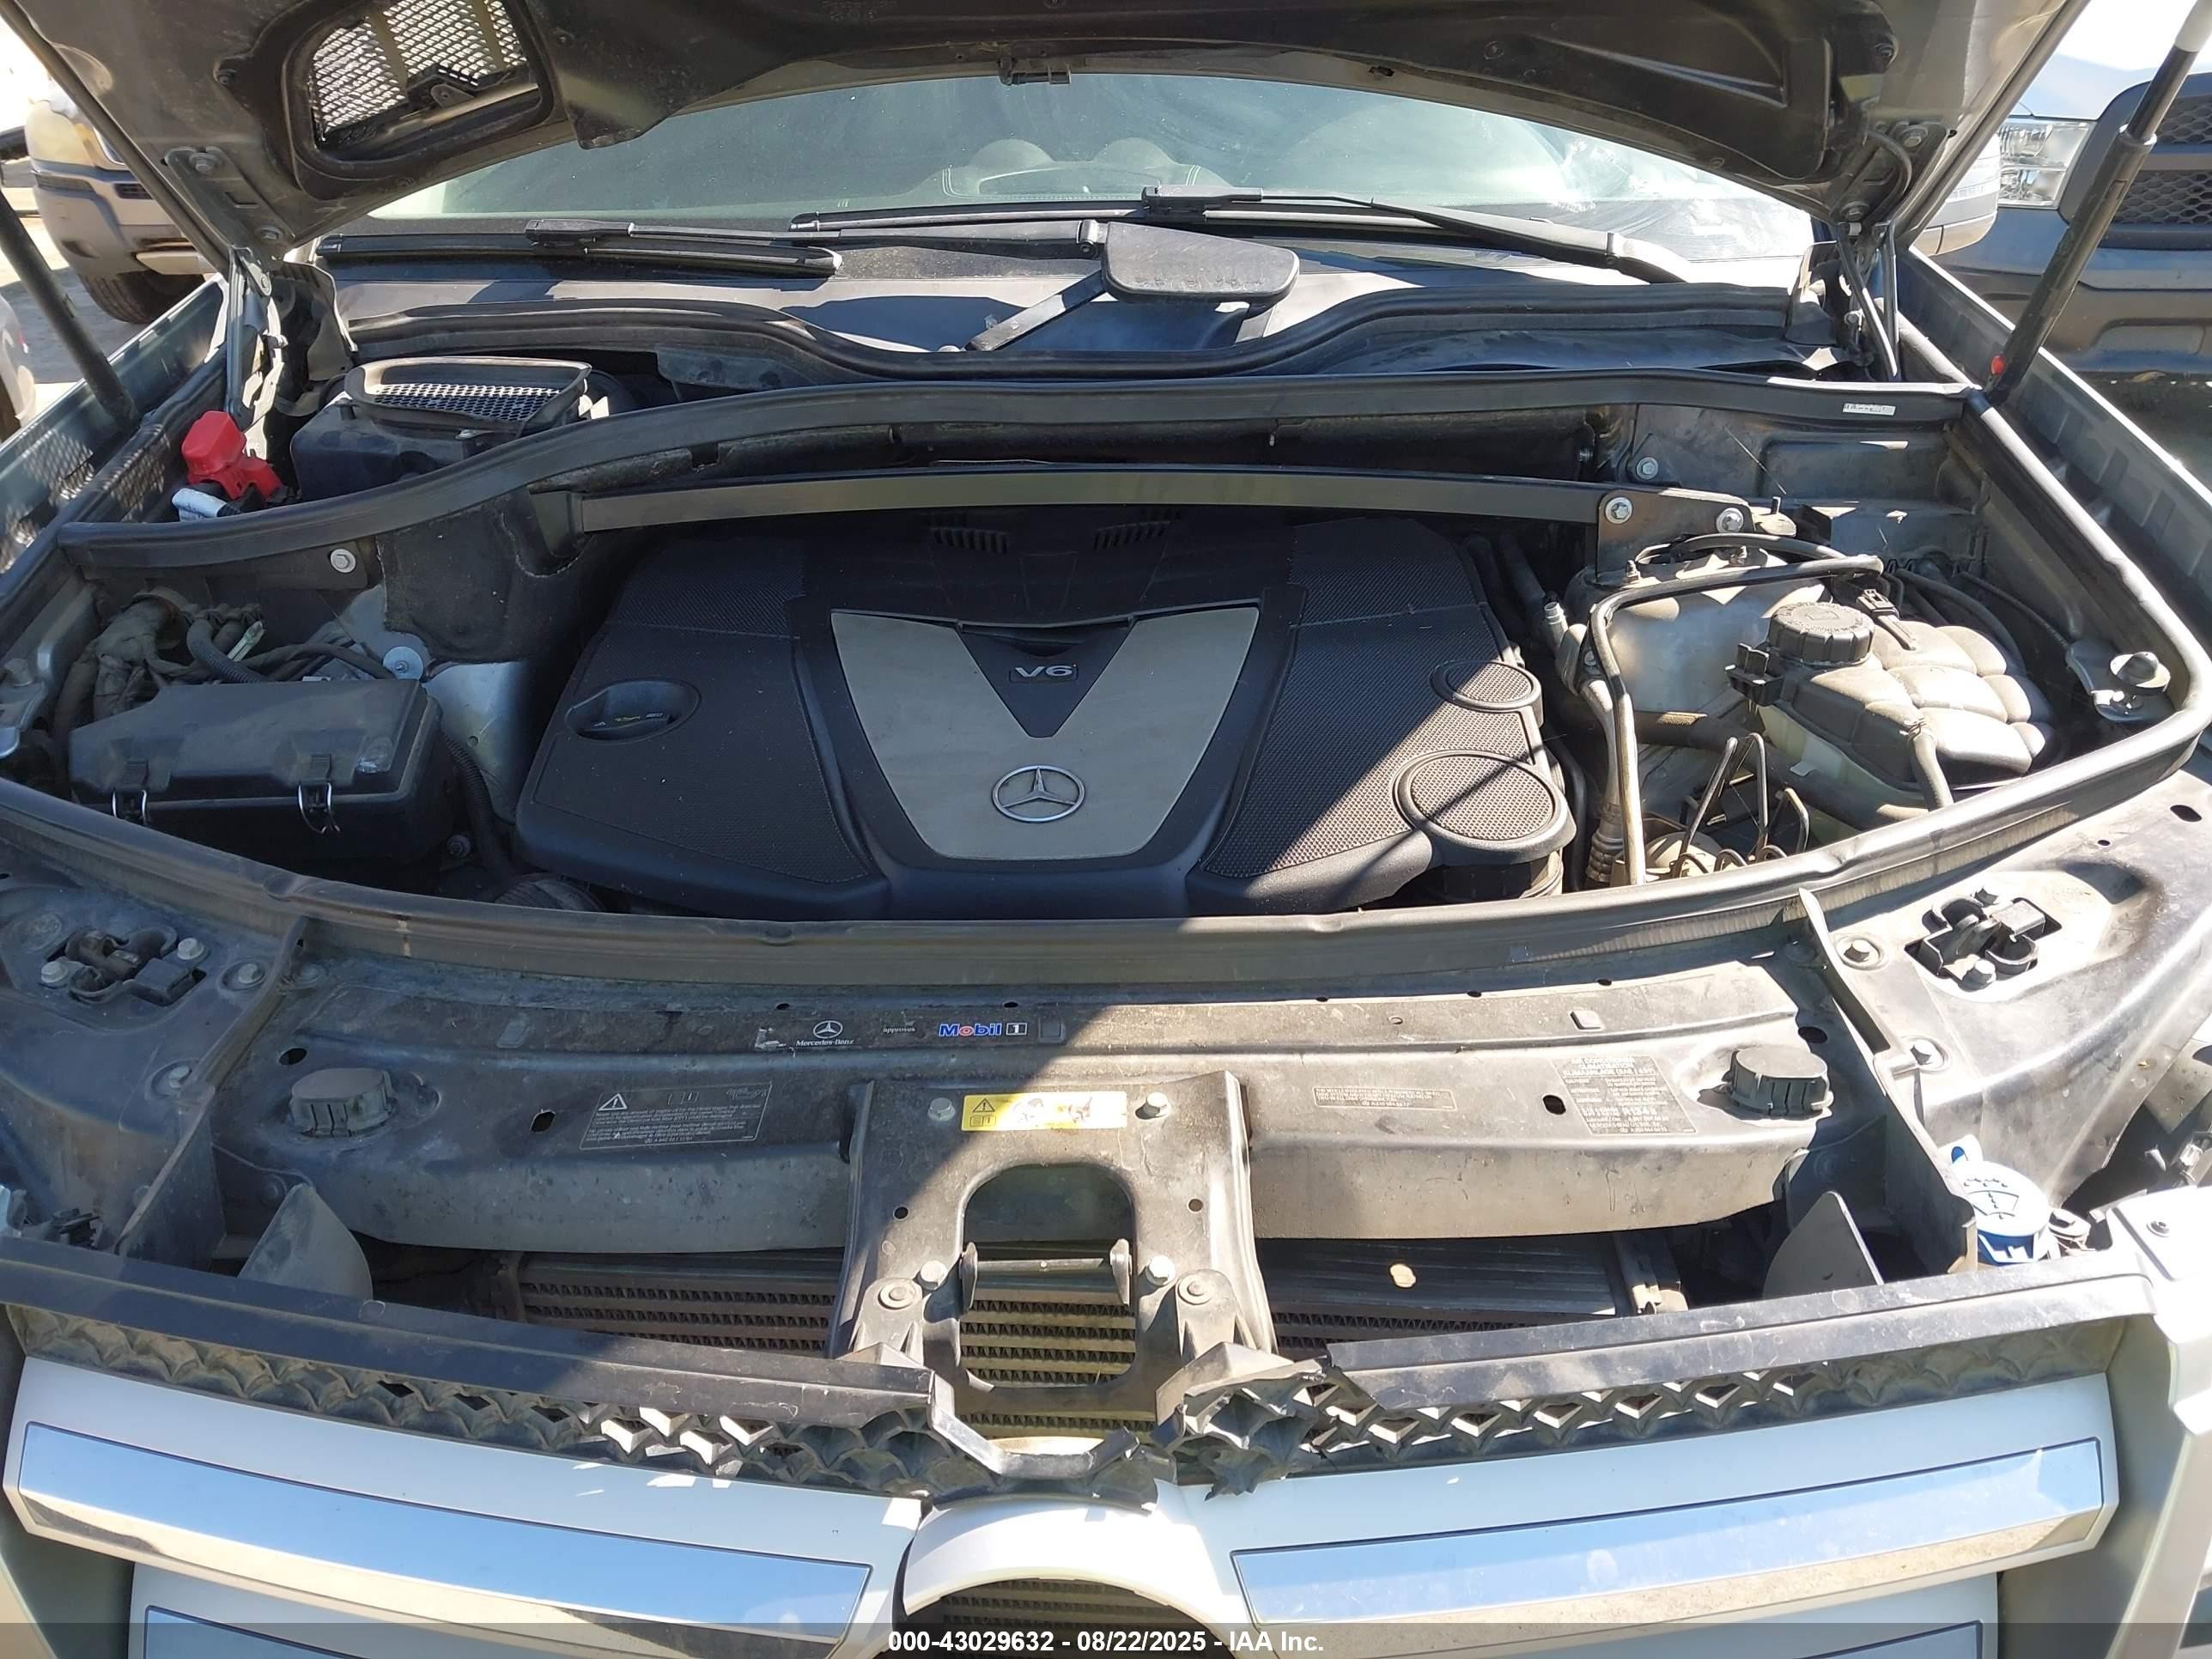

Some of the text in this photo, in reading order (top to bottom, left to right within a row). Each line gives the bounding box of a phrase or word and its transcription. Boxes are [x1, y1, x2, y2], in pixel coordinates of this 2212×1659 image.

[1015, 665, 1073, 678] V6
[939, 1023, 1002, 1036] Mobil
[795, 1038, 854, 1047] Mercedes-Benz
